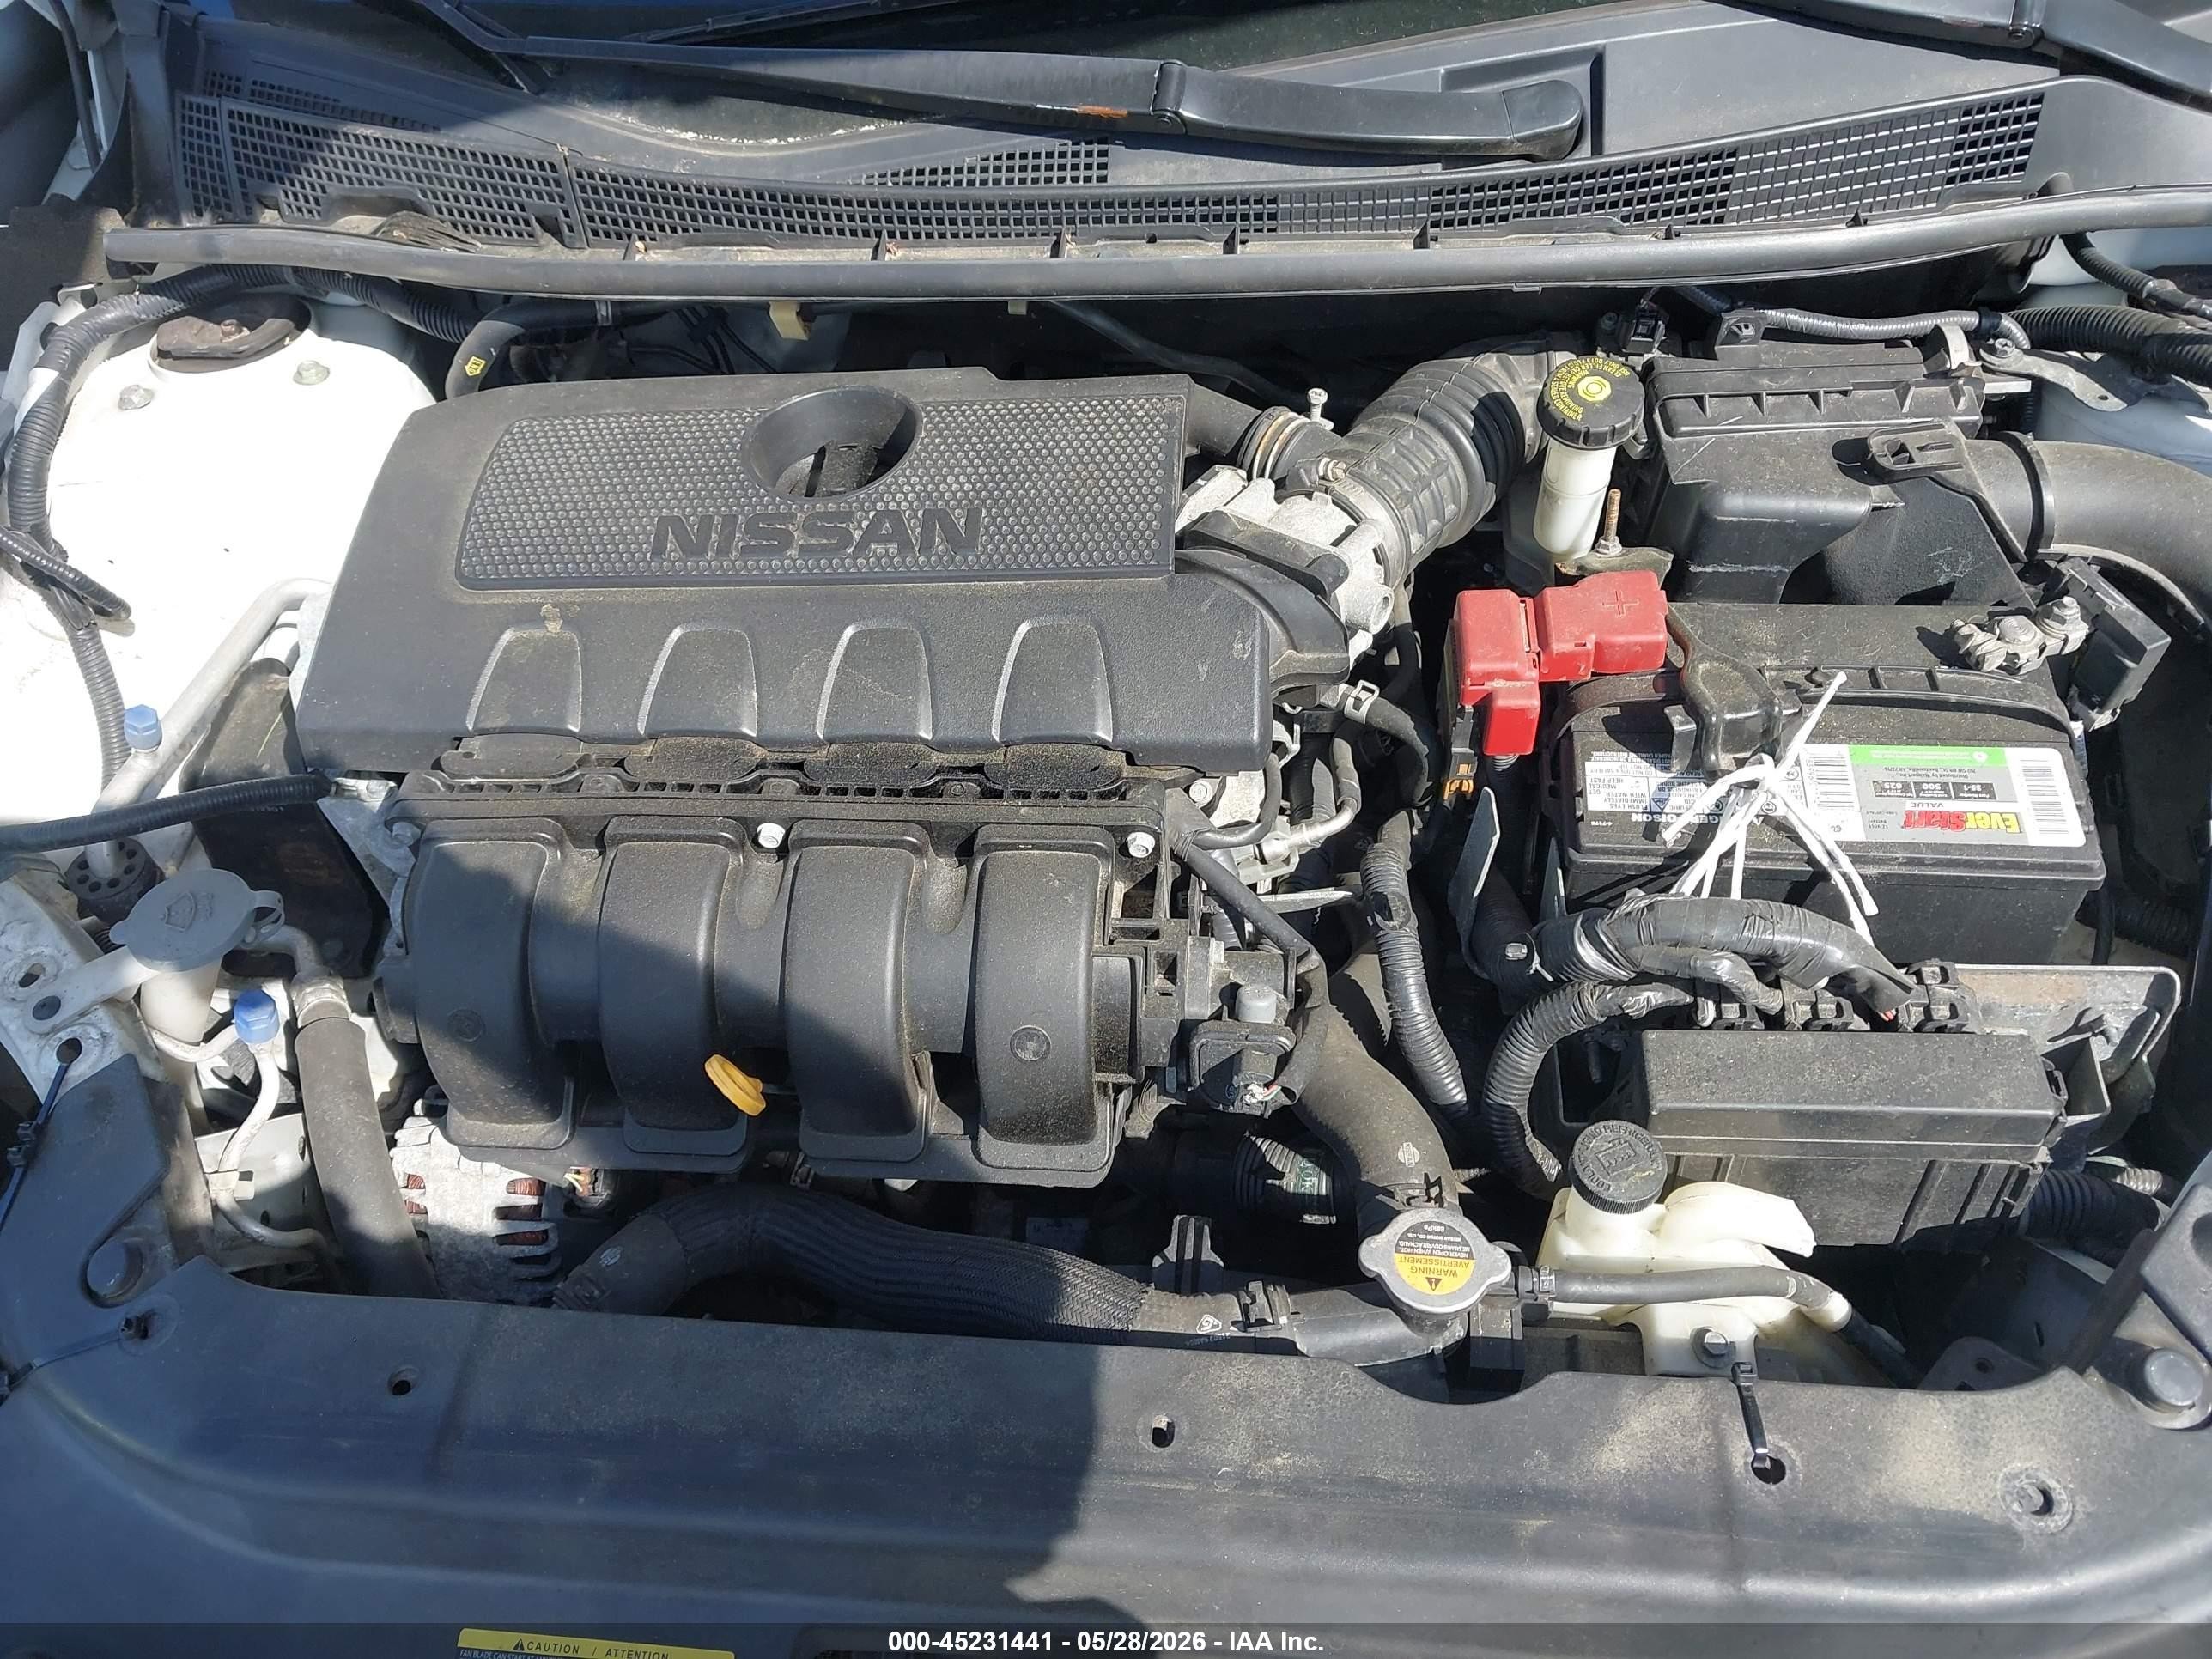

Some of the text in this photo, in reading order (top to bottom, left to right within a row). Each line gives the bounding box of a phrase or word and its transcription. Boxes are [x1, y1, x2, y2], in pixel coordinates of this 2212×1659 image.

[1602, 365, 1622, 377] CLEAN
[652, 508, 984, 561] NISSAN
[1904, 811, 2021, 834] EverStart
[1398, 1255, 1469, 1268] AVERTISSEMENT
[1410, 1267, 1457, 1278] WARNING
[526, 1641, 580, 1654] CAUTION
[605, 1649, 669, 1659] ATTENTION
